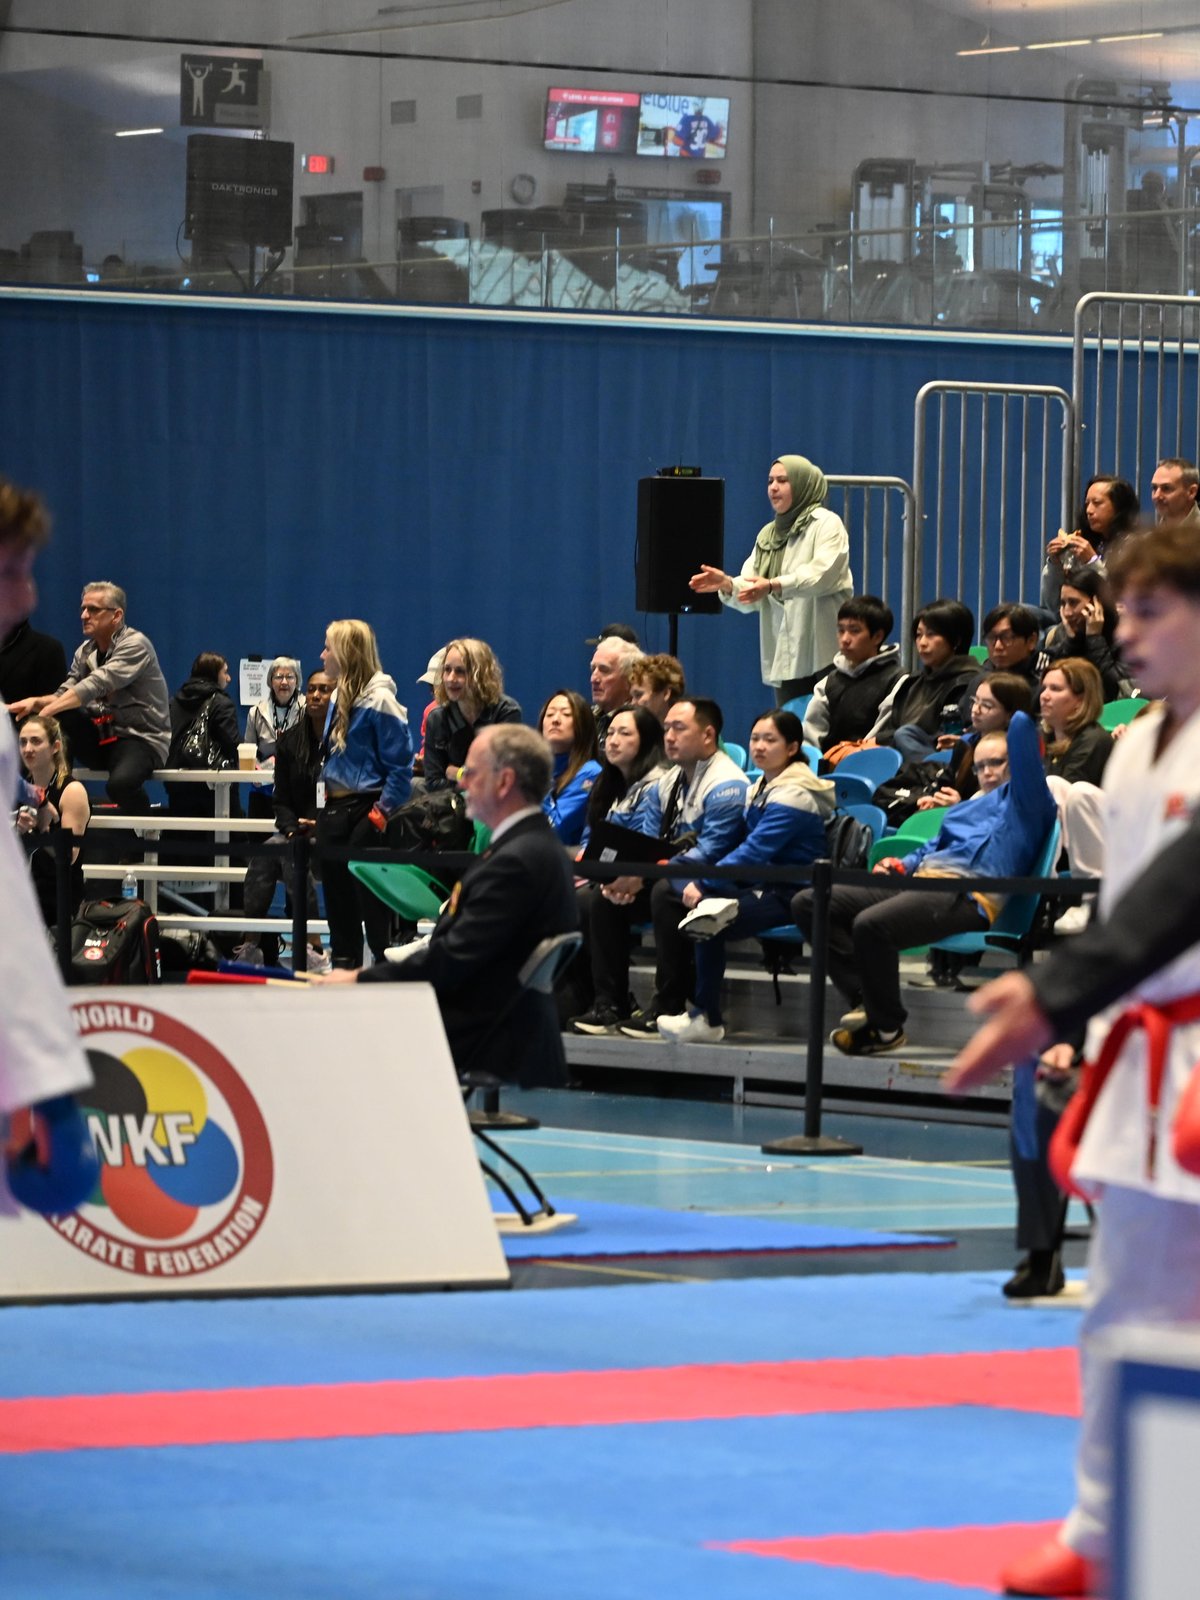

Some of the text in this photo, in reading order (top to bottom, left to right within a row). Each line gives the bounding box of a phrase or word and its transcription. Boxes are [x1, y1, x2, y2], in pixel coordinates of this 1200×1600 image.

[211, 183, 279, 196] DAKTRONICS
[51, 1194, 264, 1274] ARATE FEDERATION
